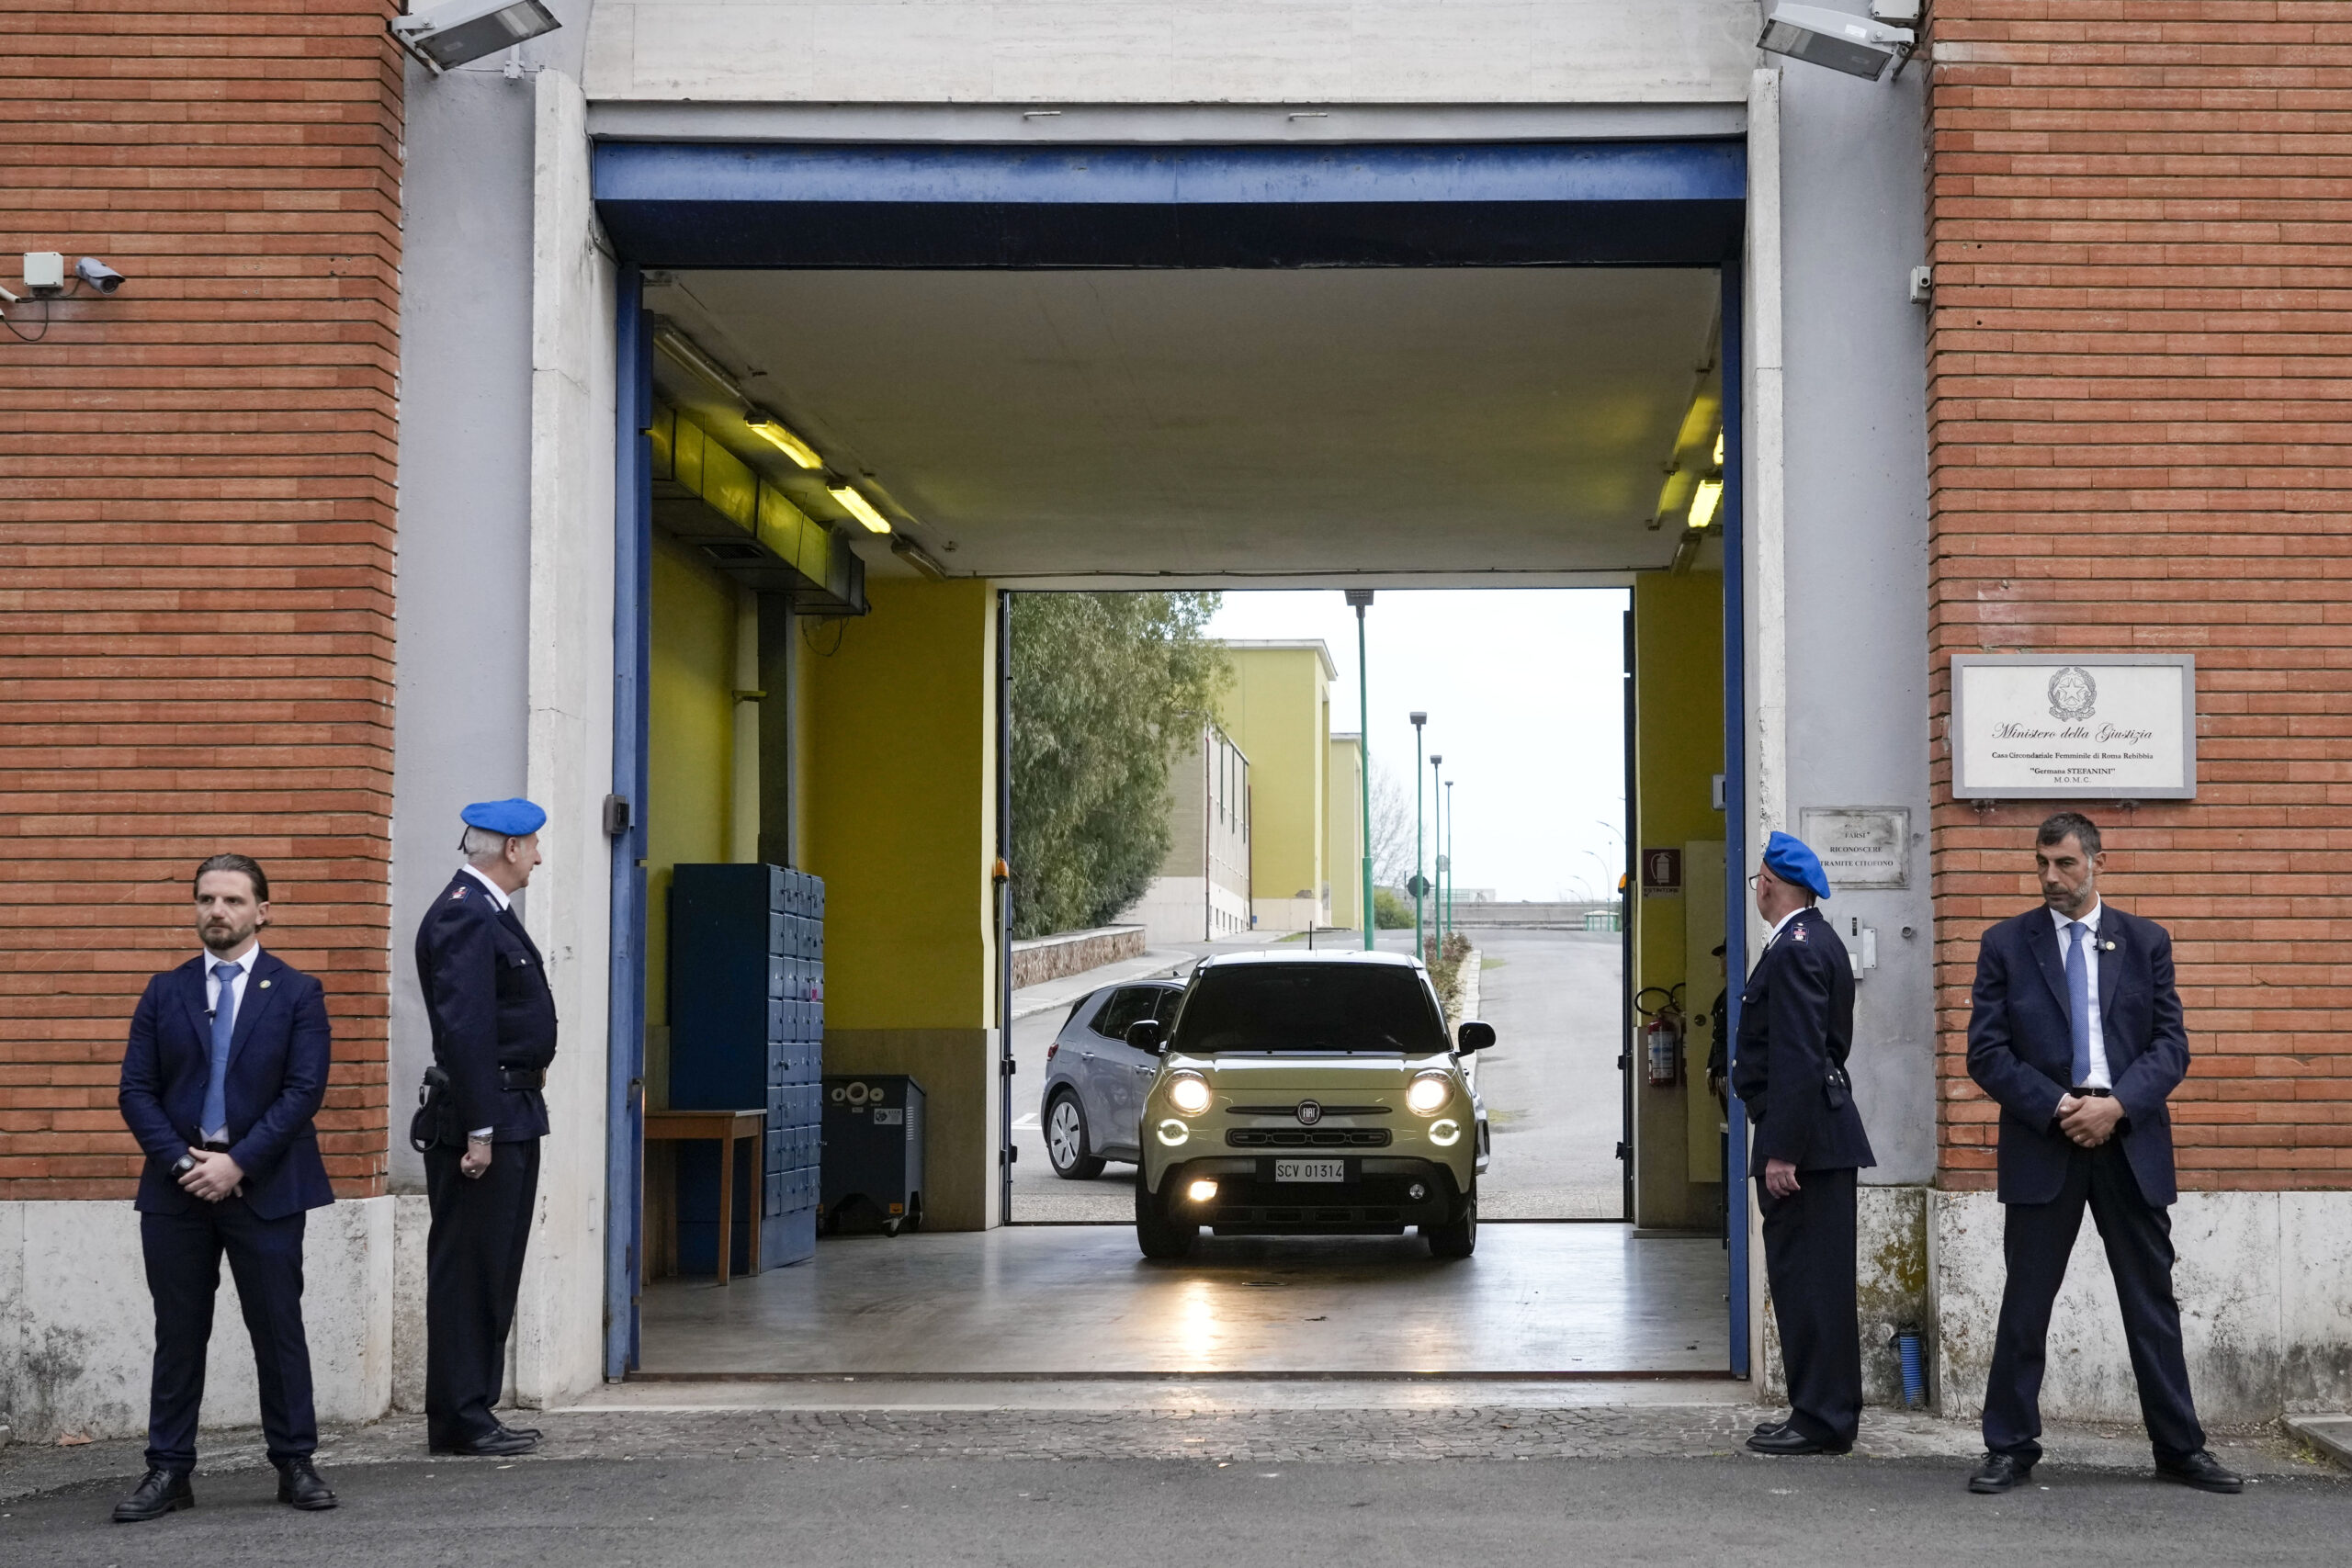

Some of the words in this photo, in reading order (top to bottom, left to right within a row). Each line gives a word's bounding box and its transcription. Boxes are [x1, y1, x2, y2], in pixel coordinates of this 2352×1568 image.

[1992, 722, 2056, 739] Ministero
[2060, 727, 2089, 739] della
[2096, 723, 2153, 745] Giustizia
[1303, 1107, 1316, 1118] FIAT
[1277, 1165, 1299, 1178] SCV
[1305, 1165, 1342, 1178] 01314
